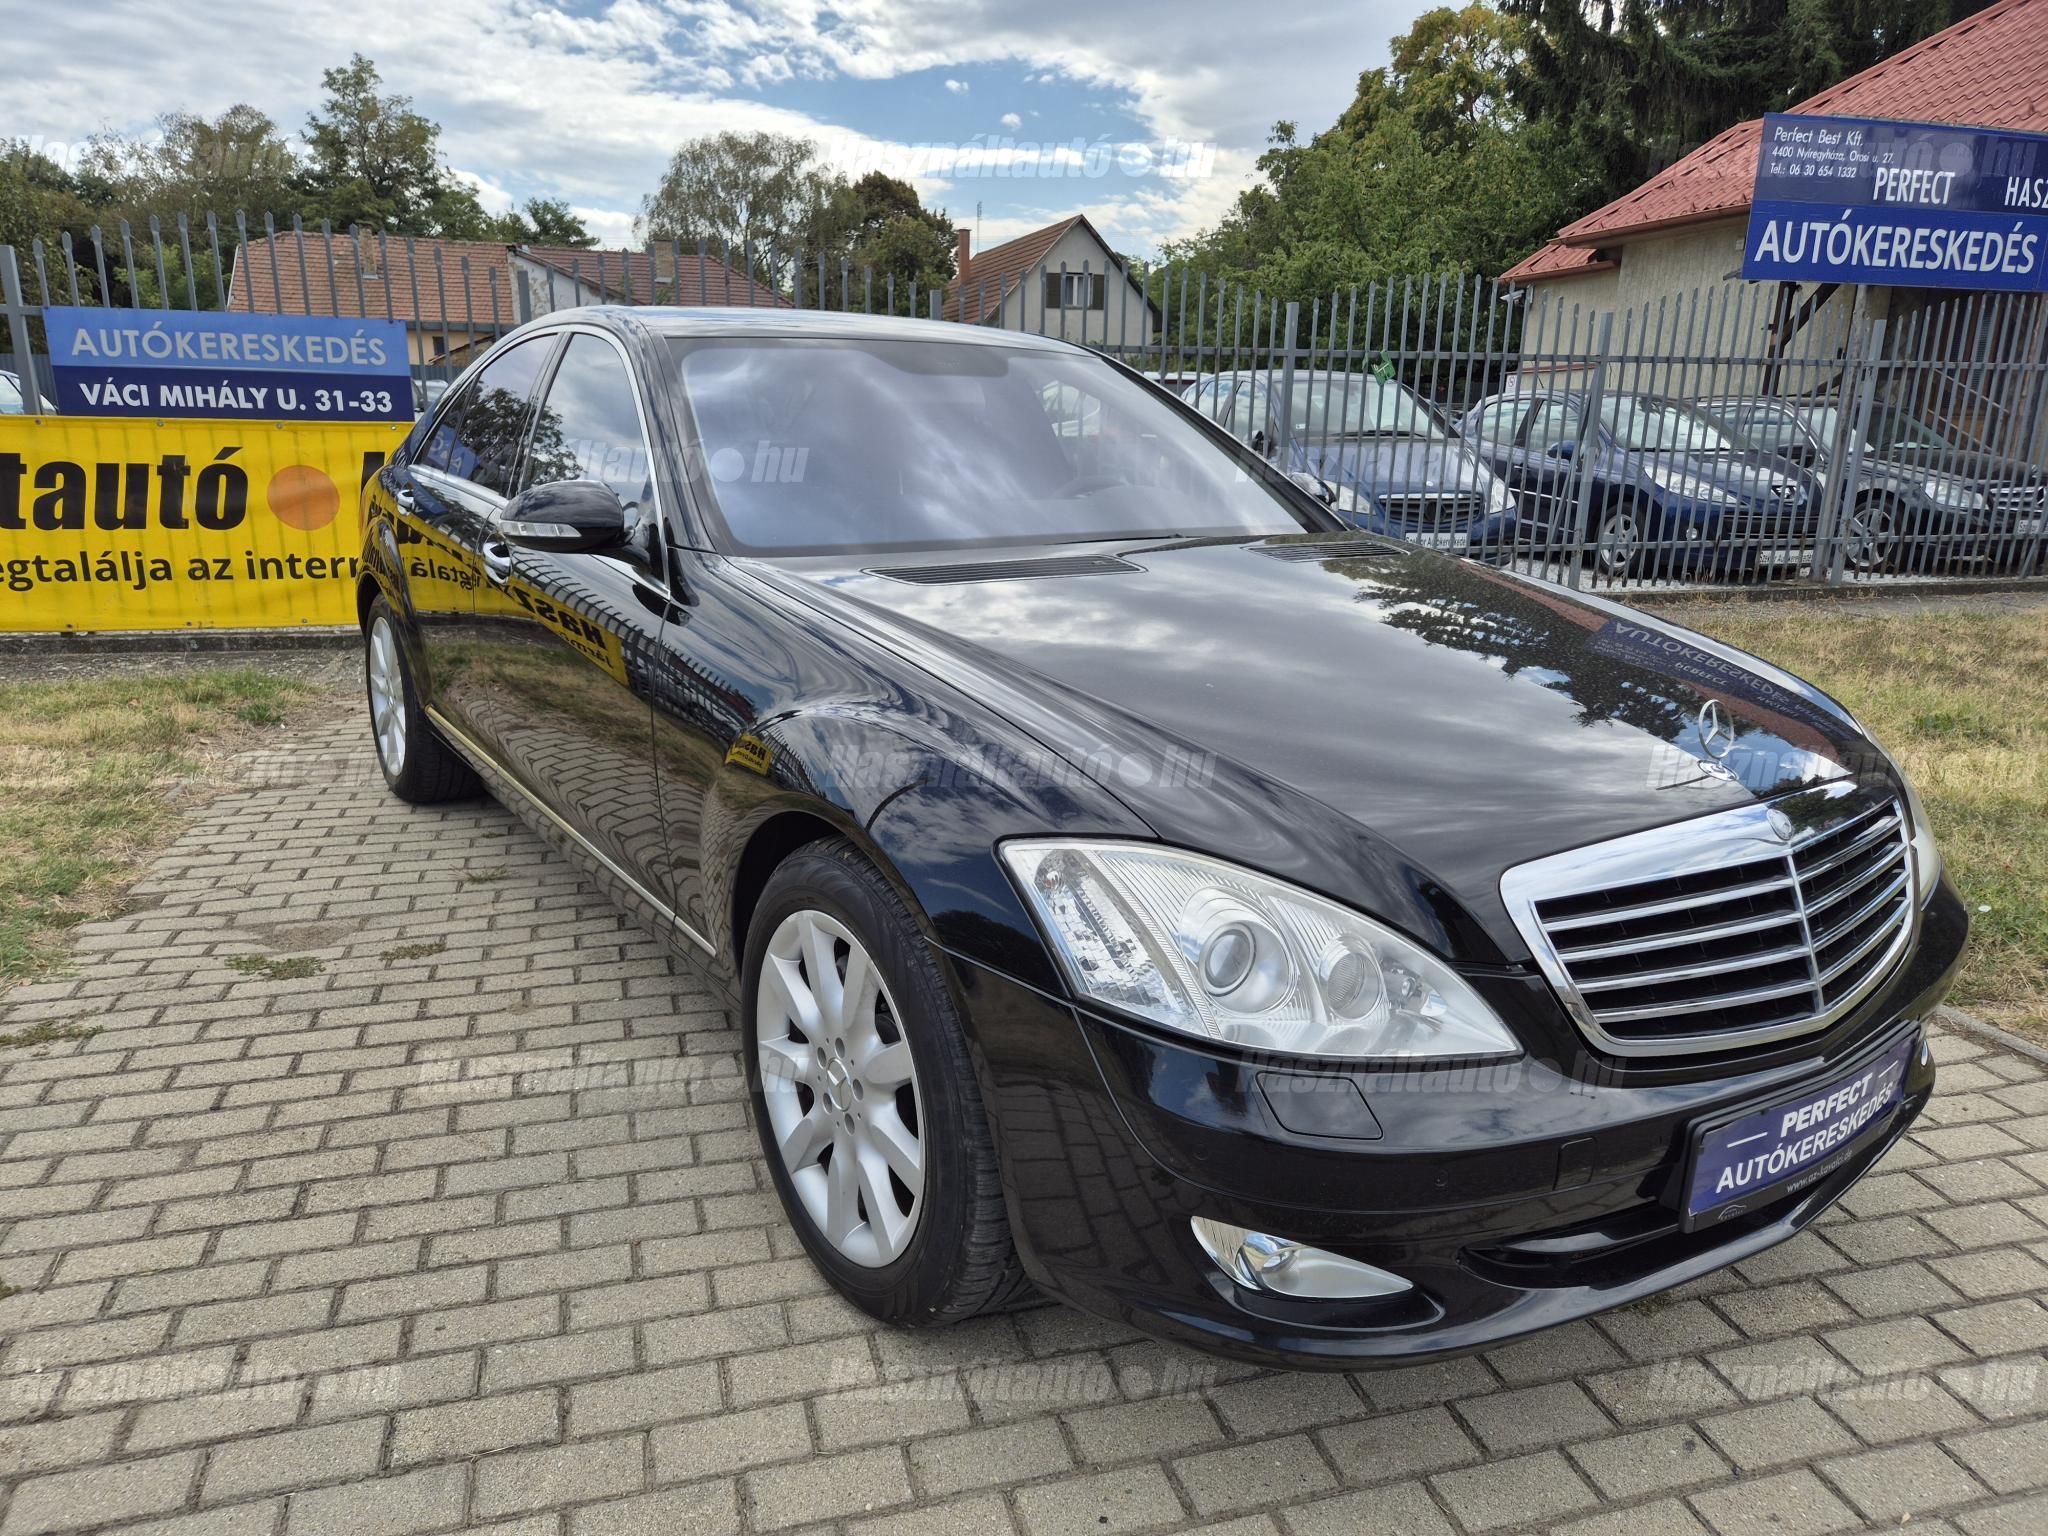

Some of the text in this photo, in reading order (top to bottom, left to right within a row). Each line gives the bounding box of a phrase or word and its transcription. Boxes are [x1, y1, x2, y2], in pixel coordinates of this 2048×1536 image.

[1772, 146, 1793, 158] 4400
[1774, 126, 1864, 146] Perfect Best Kft.
[1789, 164, 1801, 176] 06
[1803, 164, 1815, 176] 30
[1818, 165, 1833, 177] 654
[1837, 166, 1857, 178] 1332
[1873, 167, 1955, 205] PERFECT
[1754, 209, 2038, 274] AUTÓKERESKEDÉS
[72, 321, 387, 366] AUTÓKERESKEDÉS
[79, 377, 393, 413] VÁCI MIHÁLY U. 31-33
[0, 551, 172, 590] gtalálja
[188, 556, 233, 581] az
[1780, 1073, 1873, 1138] PERFECT
[1715, 1082, 1894, 1194] AUTÓKERESKEDÉS
